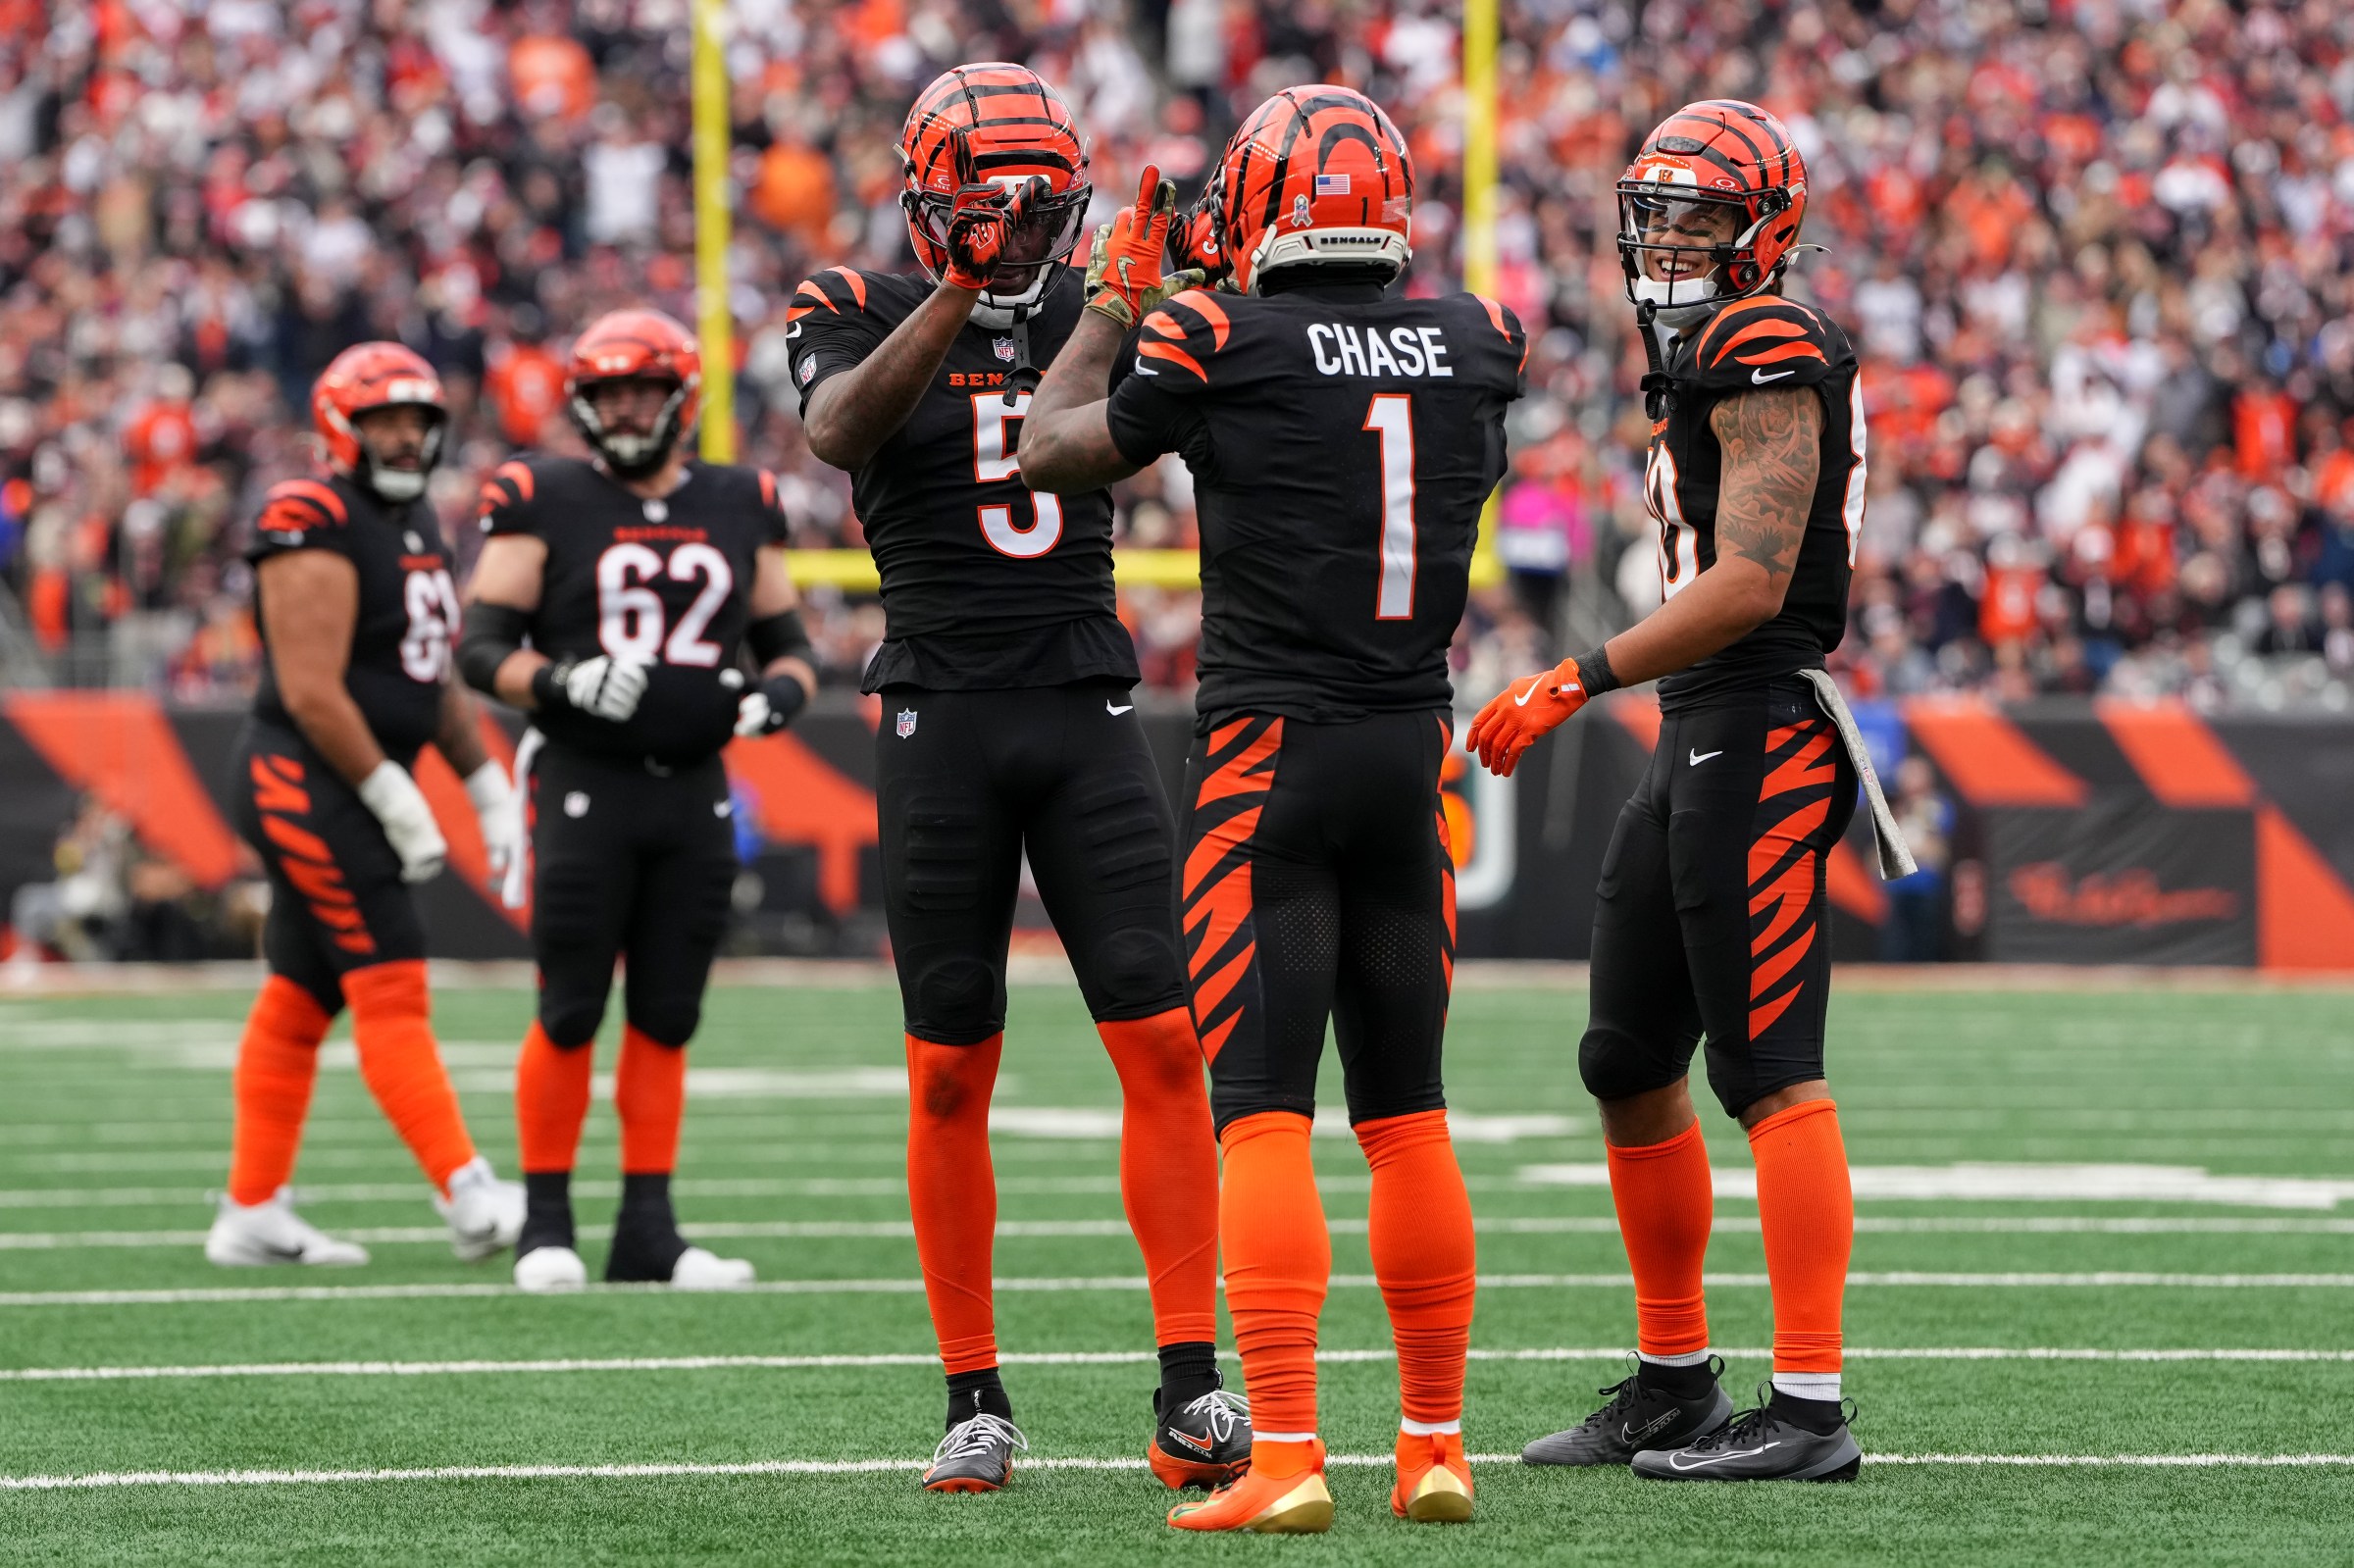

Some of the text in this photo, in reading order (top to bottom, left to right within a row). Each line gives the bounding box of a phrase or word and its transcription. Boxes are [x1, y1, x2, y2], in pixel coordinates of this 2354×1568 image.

[1306, 323, 1454, 378] CHASE
[969, 390, 1064, 559] 5
[1361, 392, 1417, 620] 1
[596, 541, 733, 668] 62
[1658, 1409, 1681, 1429] ZOOM
